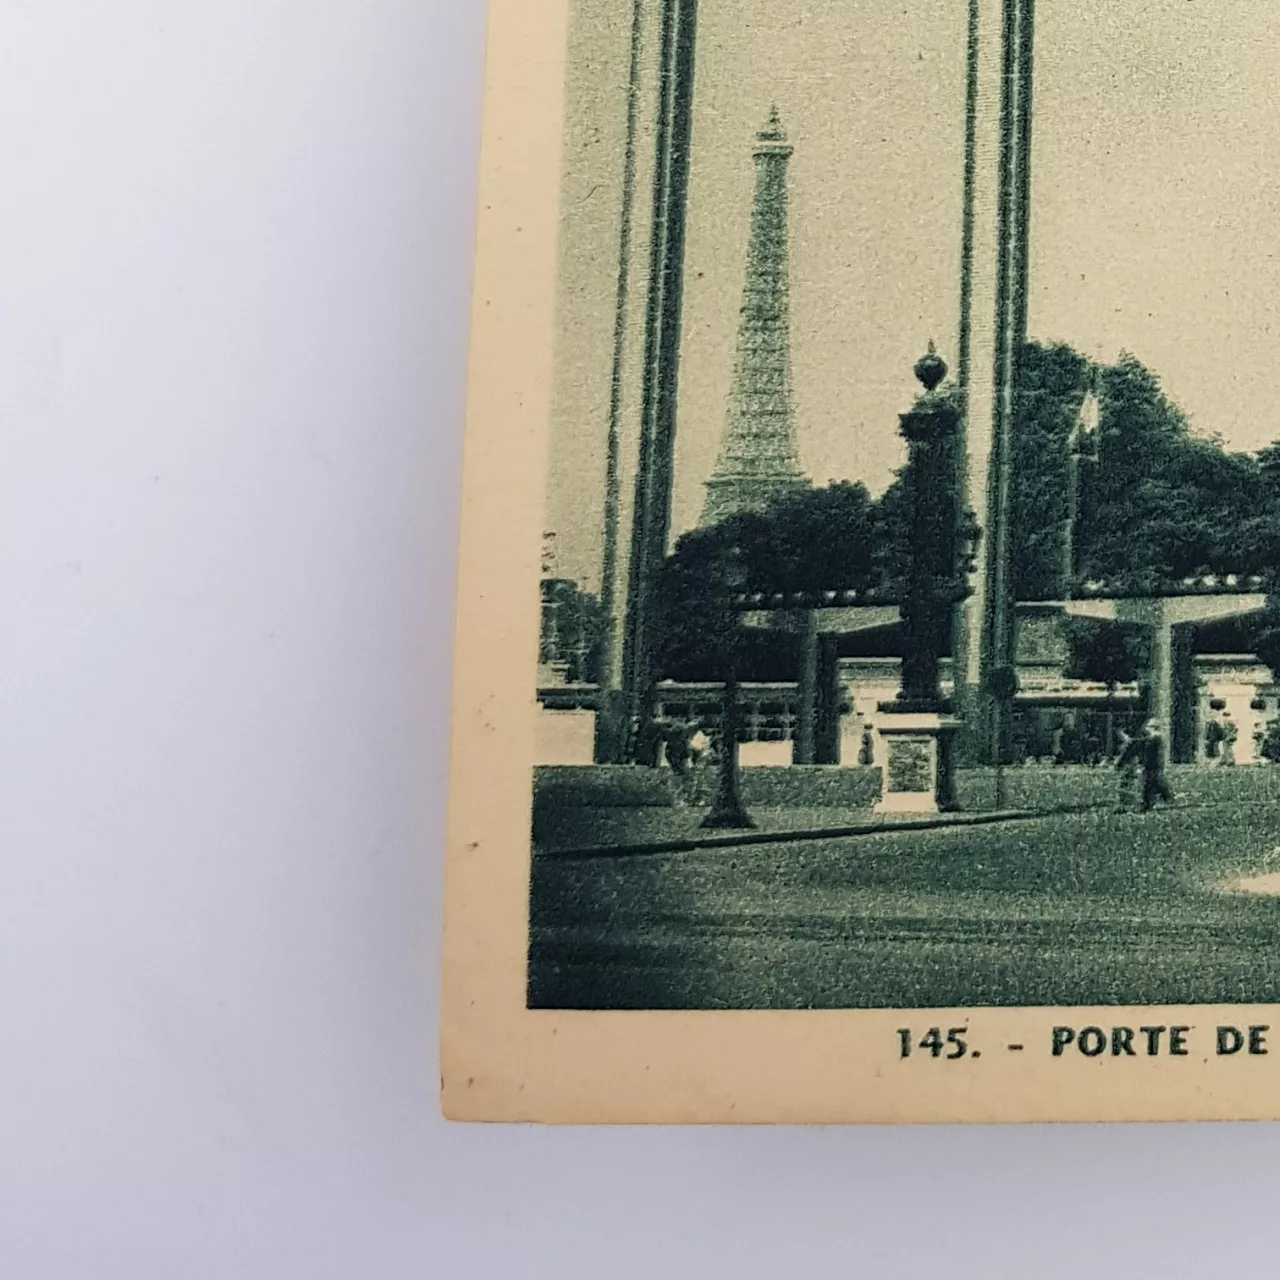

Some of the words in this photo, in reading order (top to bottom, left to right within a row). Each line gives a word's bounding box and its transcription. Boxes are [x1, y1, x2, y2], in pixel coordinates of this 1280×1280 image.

[897, 1027, 981, 1058] 145.
[1051, 1026, 1189, 1056] PORTE
[1216, 1025, 1270, 1055] DE
